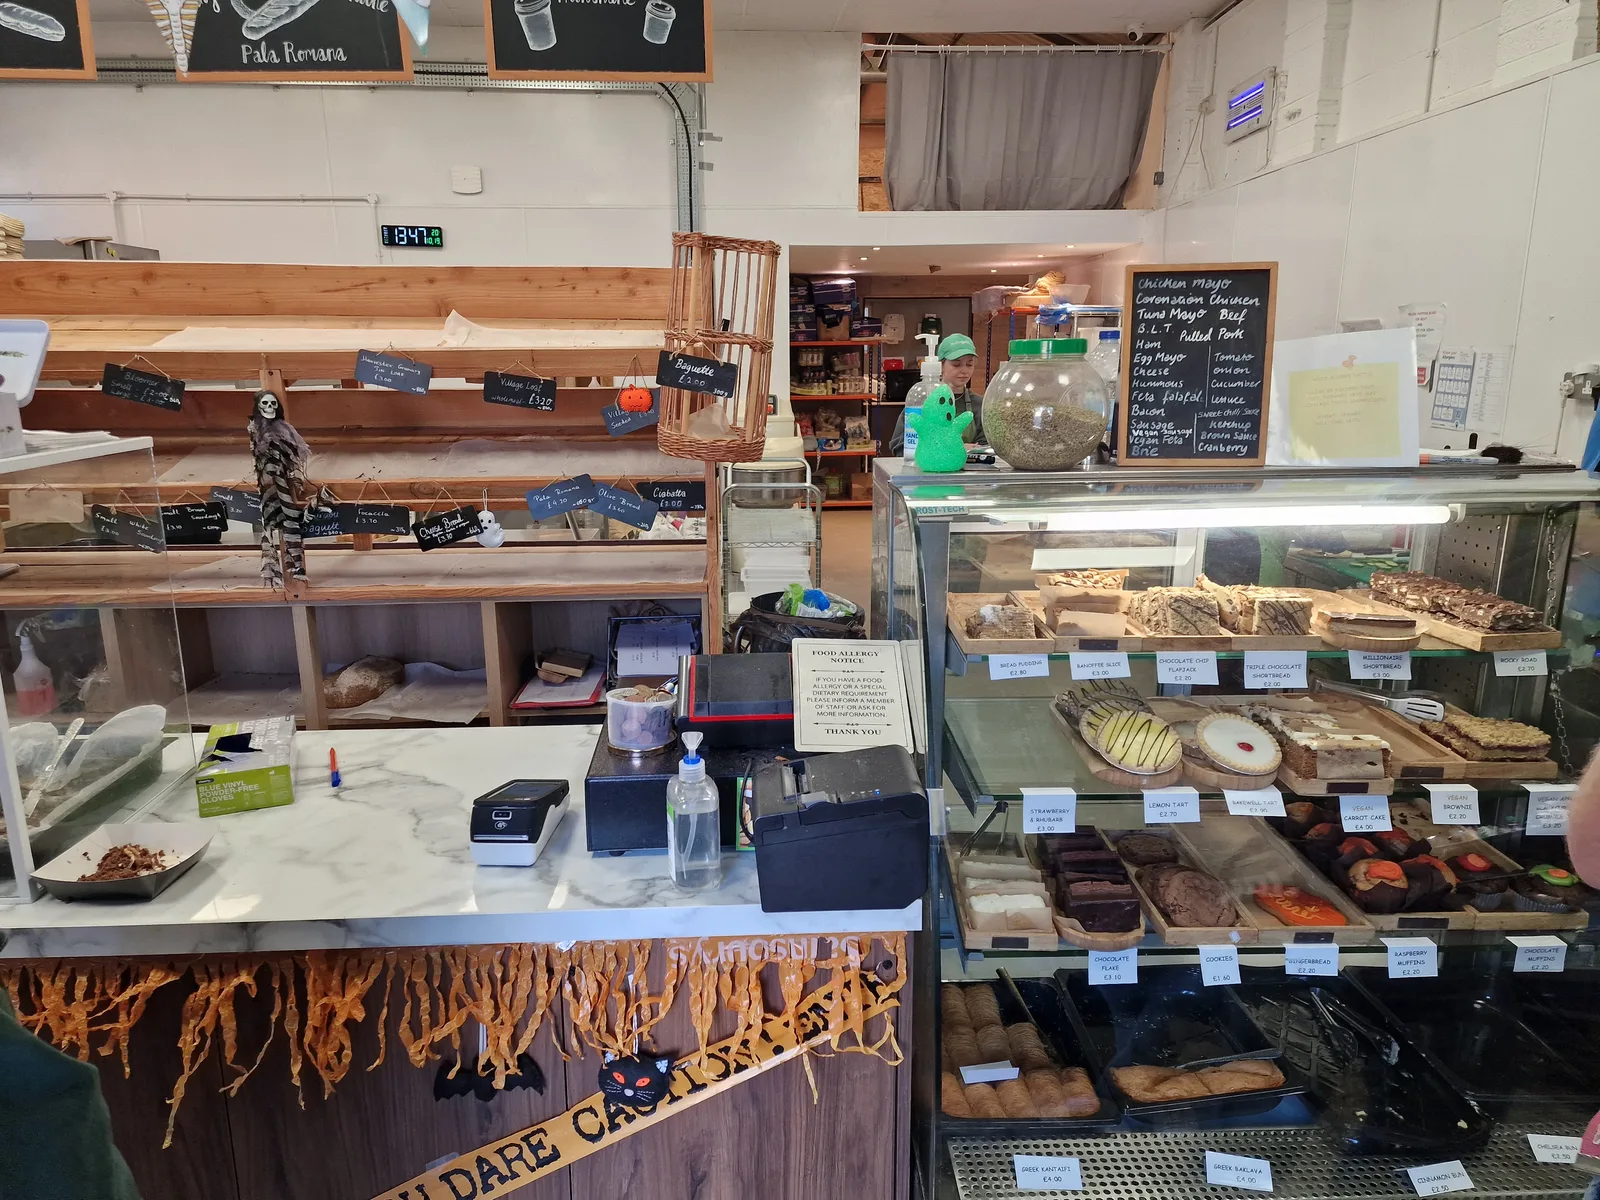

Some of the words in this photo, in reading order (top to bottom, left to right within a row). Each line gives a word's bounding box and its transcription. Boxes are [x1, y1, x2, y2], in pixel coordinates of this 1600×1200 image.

[241, 41, 280, 64] Pala
[283, 41, 347, 63] Romana
[1139, 278, 1186, 289] Chicken
[1136, 293, 1204, 304] Coronation
[1210, 294, 1260, 306] Chicken
[1137, 309, 1165, 320] Tuna
[1170, 308, 1207, 323] Mayo
[1220, 309, 1247, 325] Beef
[1180, 328, 1212, 341] Pulled
[1218, 328, 1244, 340] Pork
[1136, 339, 1161, 349] Ham
[1133, 353, 1152, 365] Egg
[1155, 353, 1187, 365] Mayo
[1214, 352, 1255, 362] Tomato
[675, 359, 714, 376] Baguette
[1133, 366, 1169, 376] Cheese
[124, 372, 160, 386] Bloomer
[500, 378, 523, 391] Village
[1211, 379, 1261, 388] Cucumber
[1132, 391, 1155, 401] Feta
[1132, 405, 1165, 416] Bacon
[1130, 419, 1174, 430] Sausage
[1201, 431, 1231, 440] Brown
[1234, 432, 1257, 440] Sauce
[1129, 436, 1159, 447] Vegan
[1162, 436, 1183, 445] Feta
[1132, 446, 1159, 456] Brie
[1198, 443, 1248, 456] Cranberry
[555, 486, 580, 495] Romana
[653, 487, 686, 498] Ciabatta
[598, 488, 616, 500] Olive
[620, 497, 641, 510] Bread
[358, 508, 390, 516] Focaccia
[95, 513, 118, 524] Small
[419, 525, 443, 538] Cheese
[442, 514, 464, 529] Bread
[199, 785, 221, 793] BLUE
[222, 780, 246, 789] VINYL
[199, 784, 259, 800] POWDER-FREE
[200, 794, 234, 804] GLOVES
[438, 1128, 561, 1200] DARE
[1235, 1166, 1262, 1174] BAKLAVA
[1417, 1173, 1451, 1184] CINNAMON
